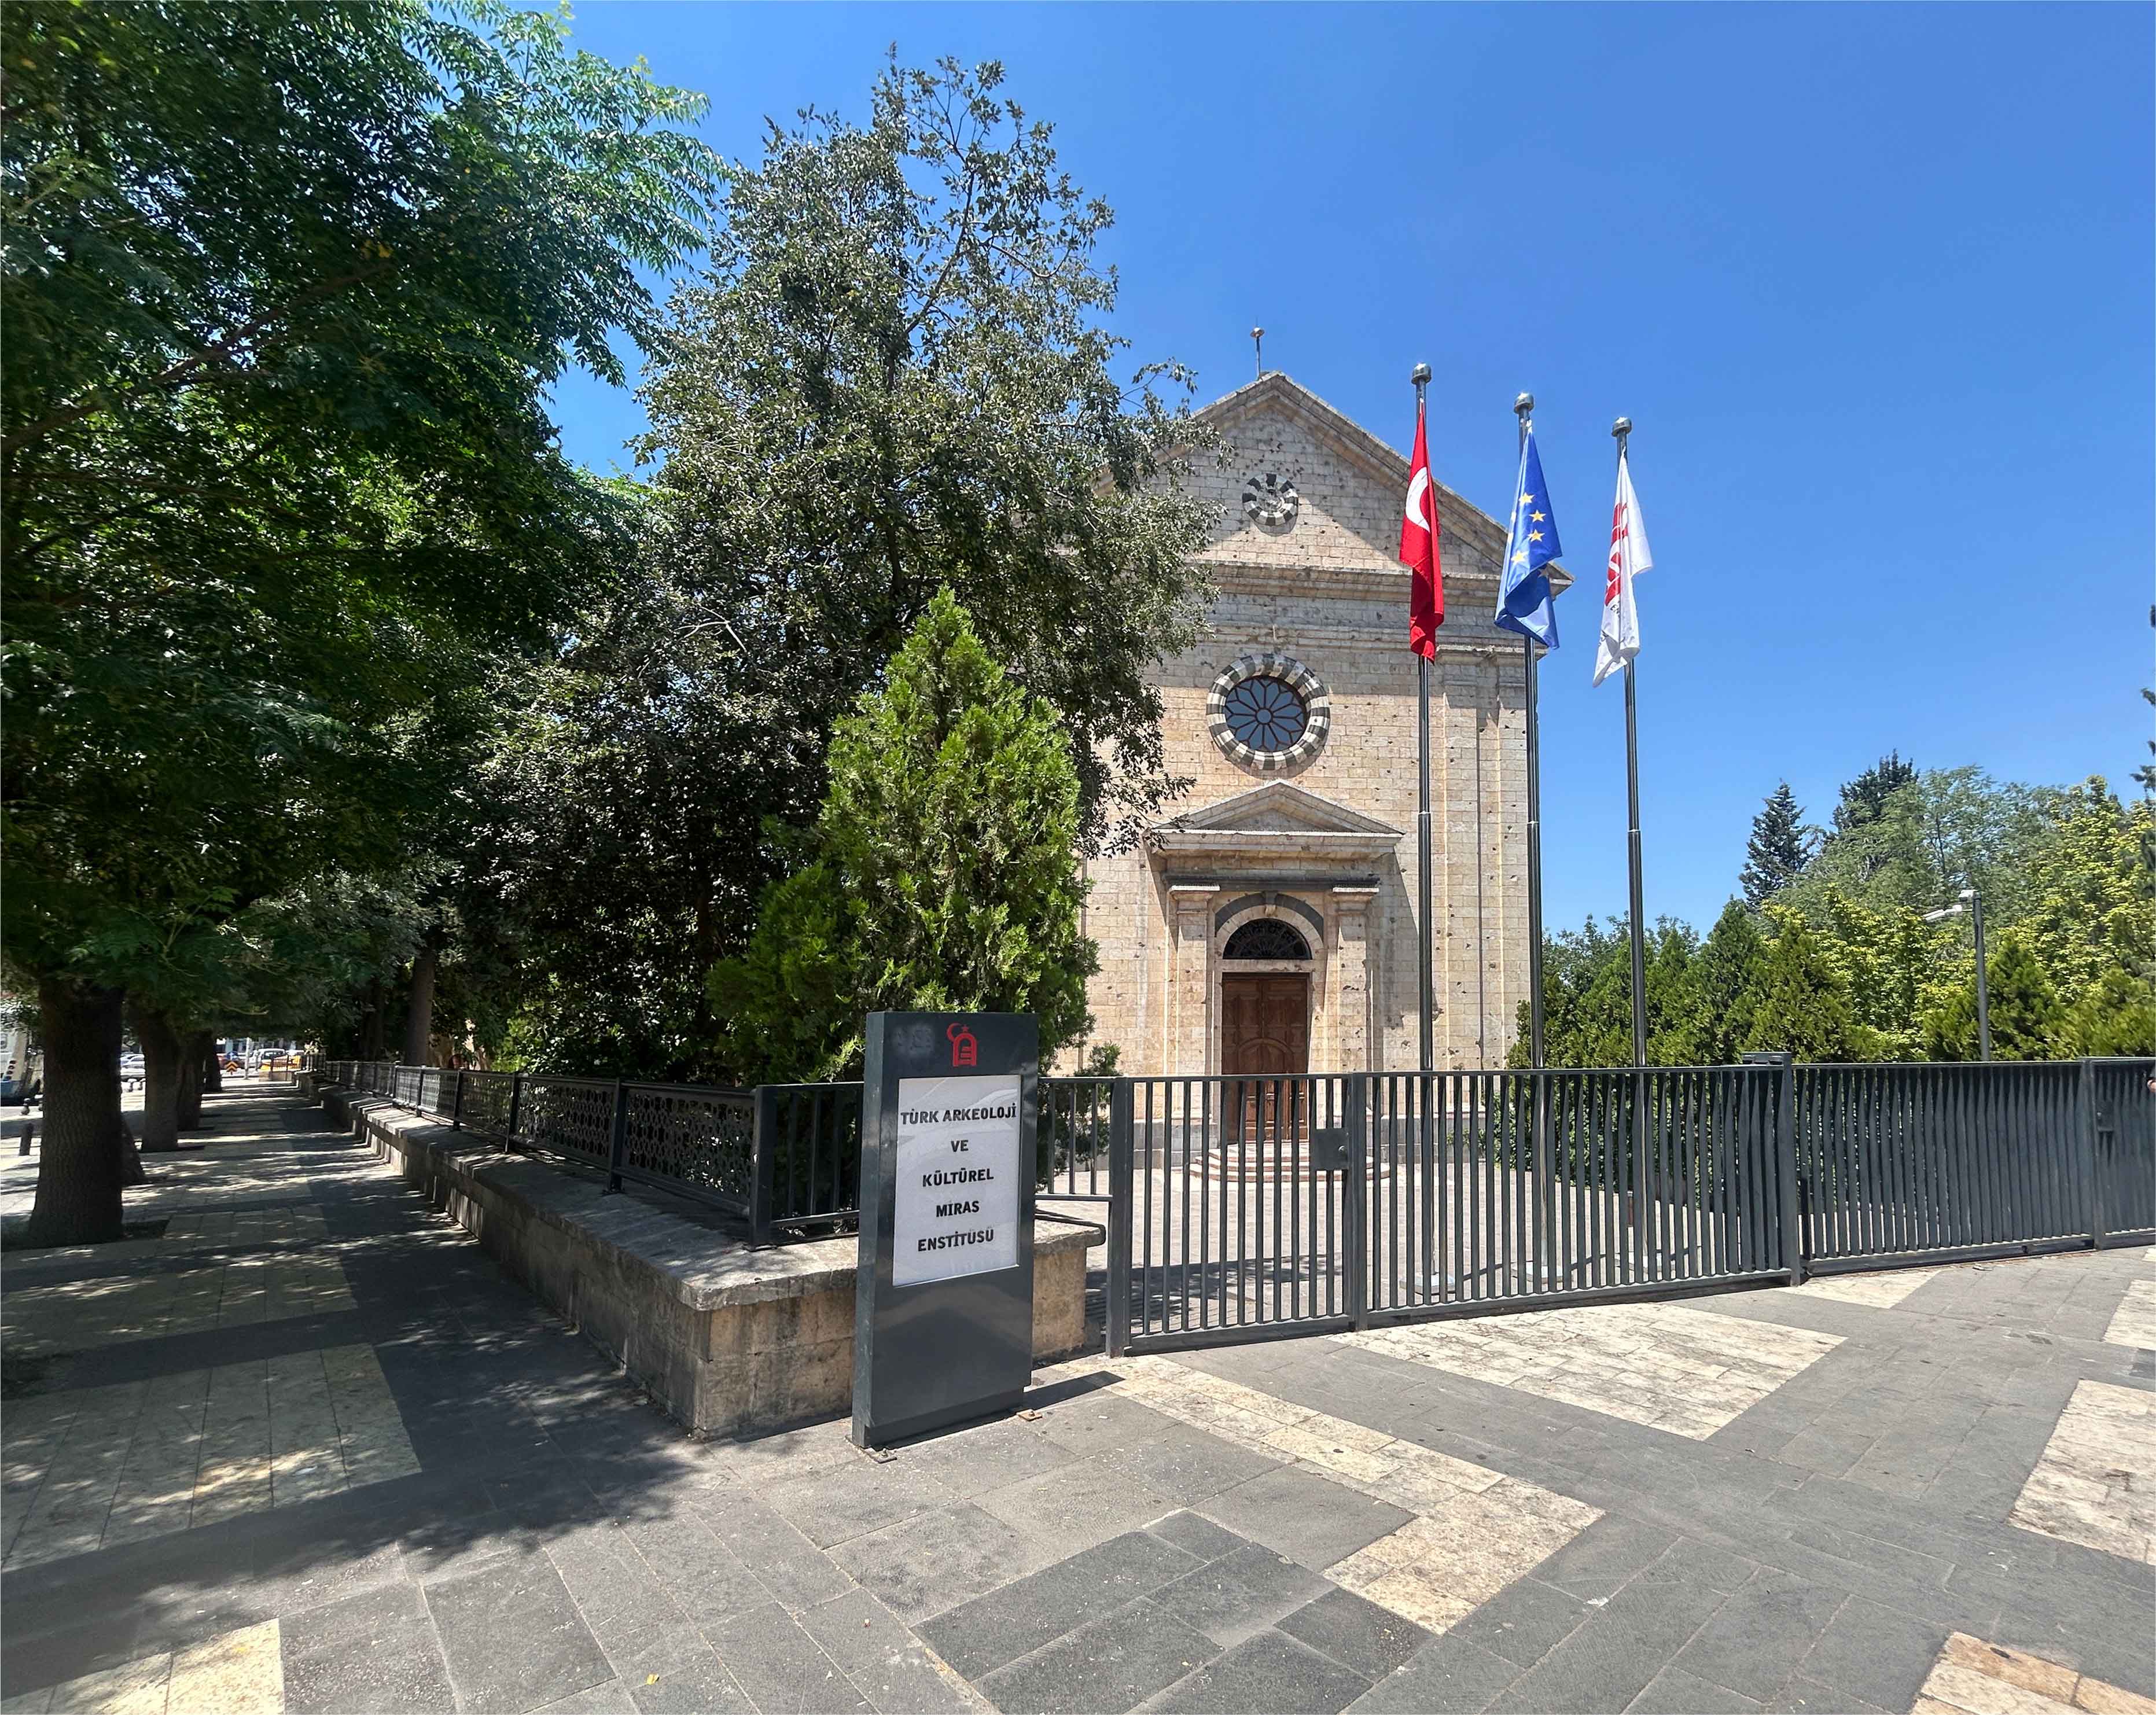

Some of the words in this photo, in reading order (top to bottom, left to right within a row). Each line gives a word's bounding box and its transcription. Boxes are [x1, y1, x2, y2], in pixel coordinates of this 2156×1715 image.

[943, 1103, 1017, 1121] ARKEOLOJİ
[951, 1139, 969, 1152] VE
[922, 1168, 994, 1187] KÜLTÜREL
